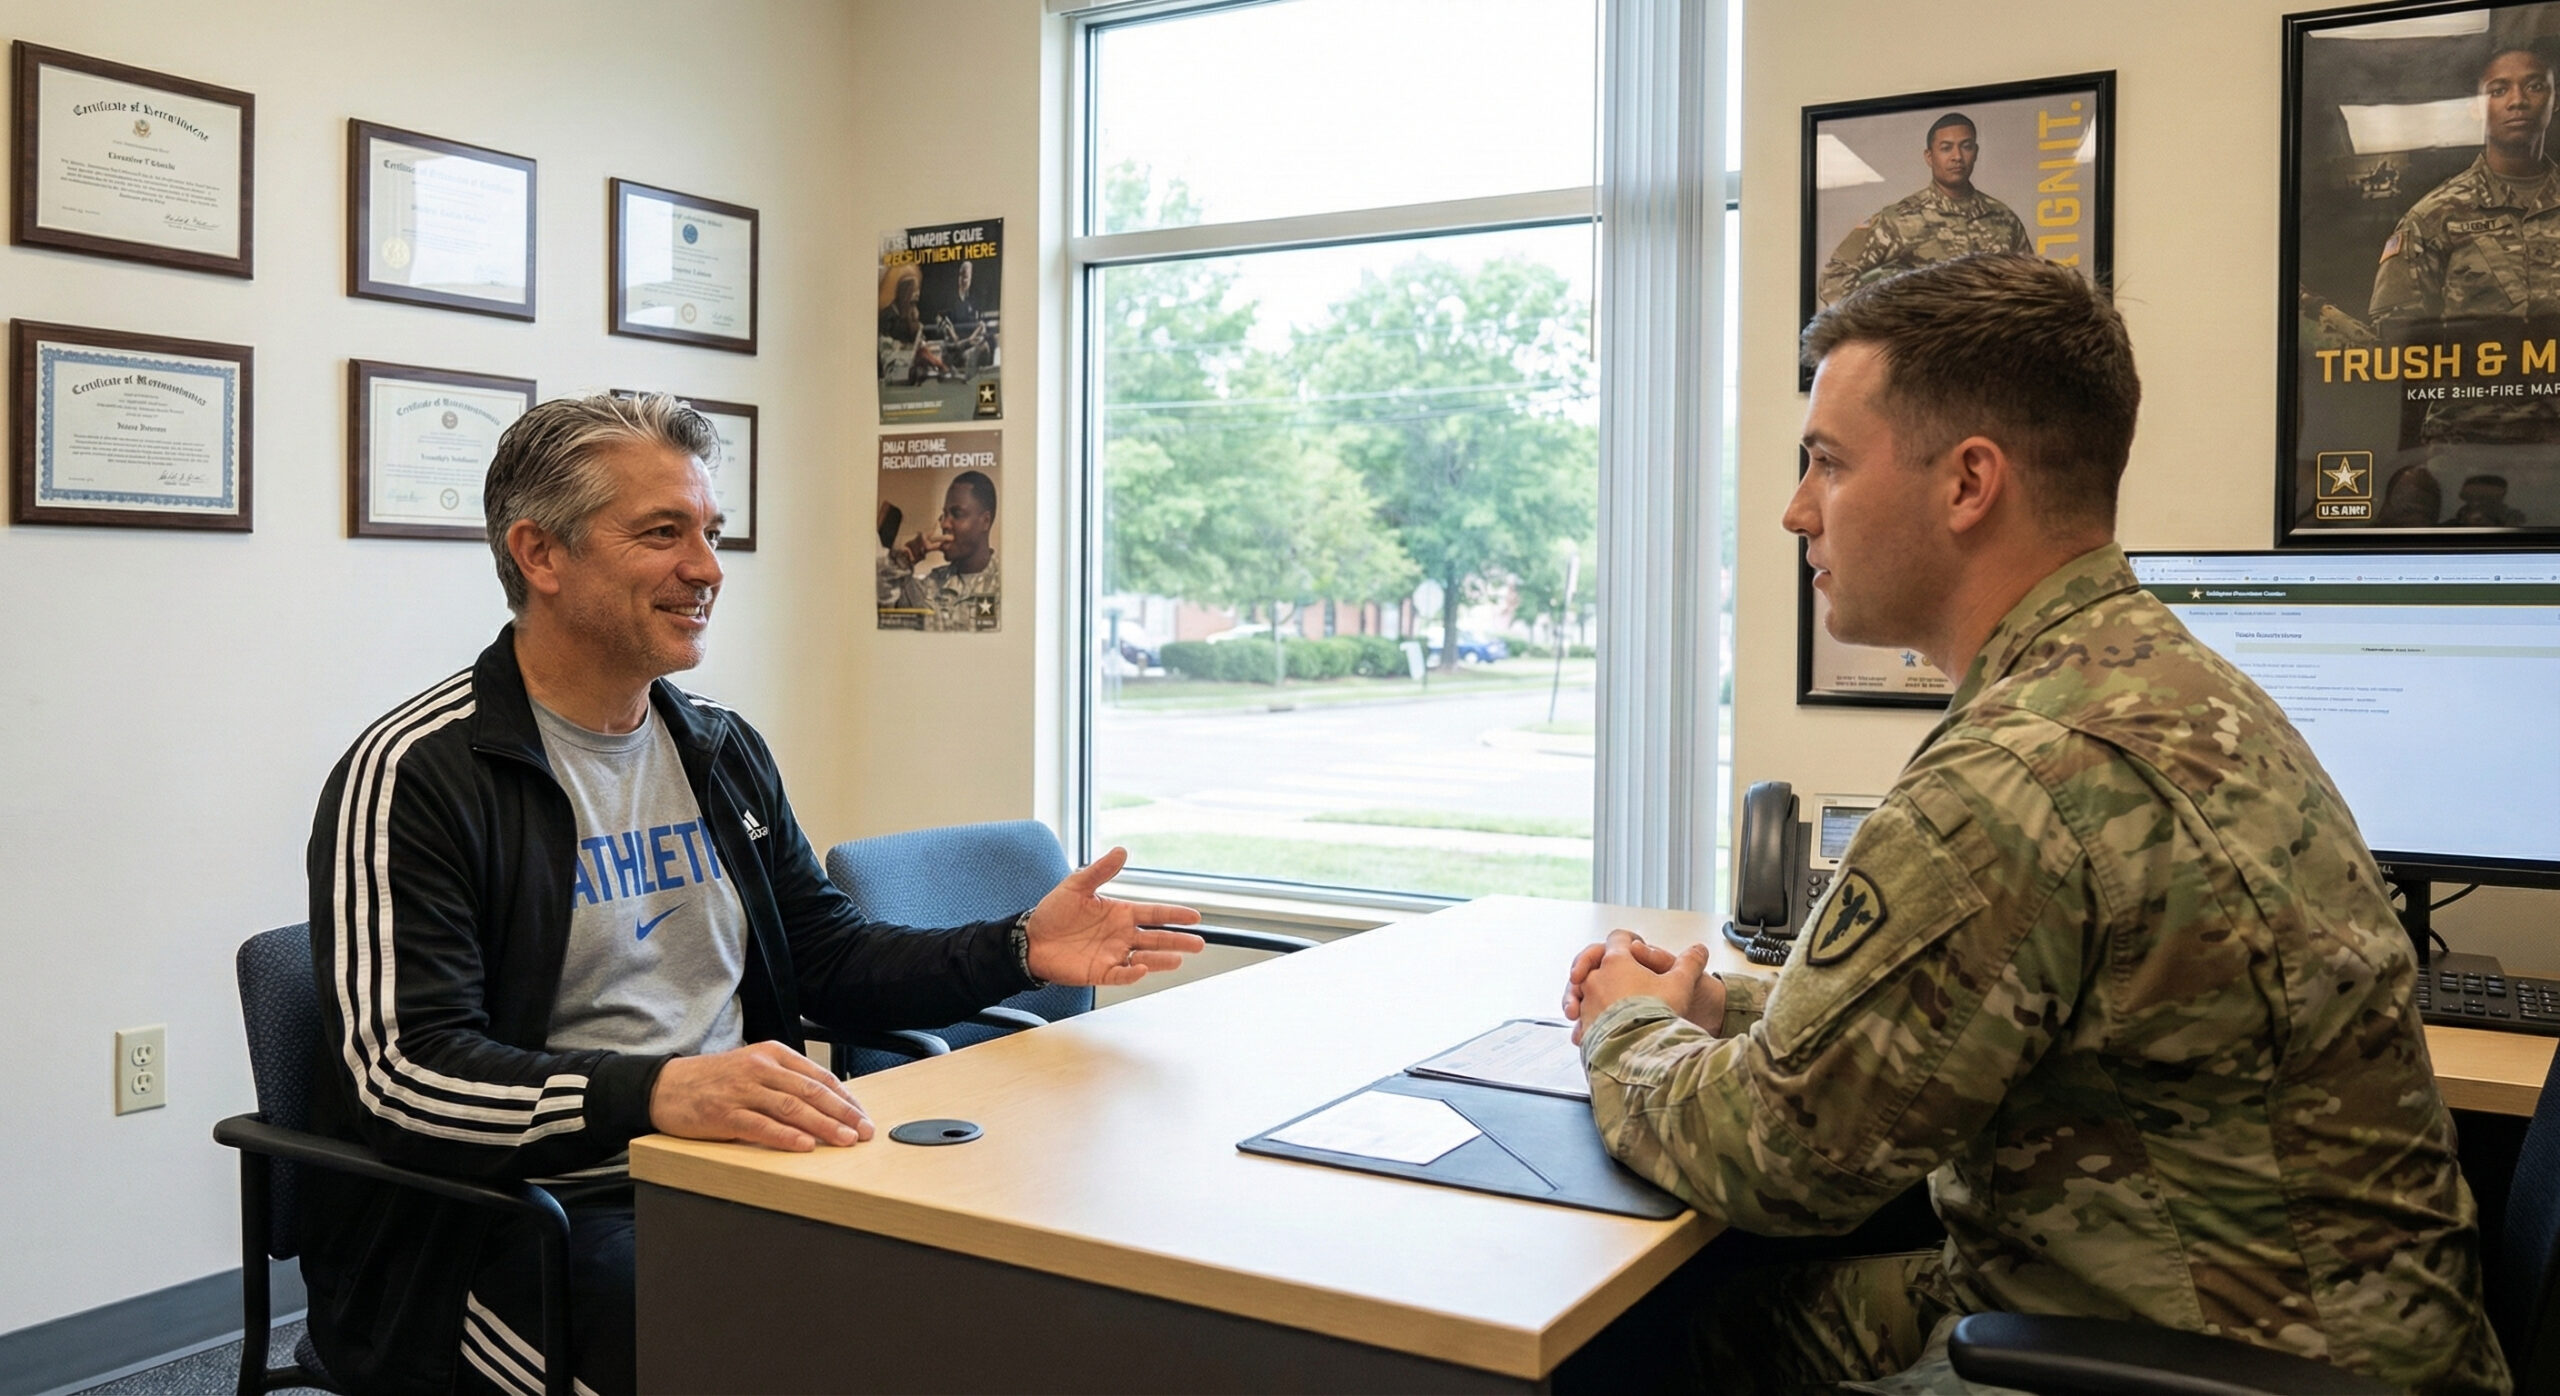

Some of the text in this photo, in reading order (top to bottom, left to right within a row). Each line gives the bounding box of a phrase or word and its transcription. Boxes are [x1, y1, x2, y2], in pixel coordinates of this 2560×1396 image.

[965, 242, 997, 260] HERE
[2316, 343, 2461, 383] TRUSH
[2477, 342, 2507, 376] &
[2407, 387, 2445, 400] KAKE
